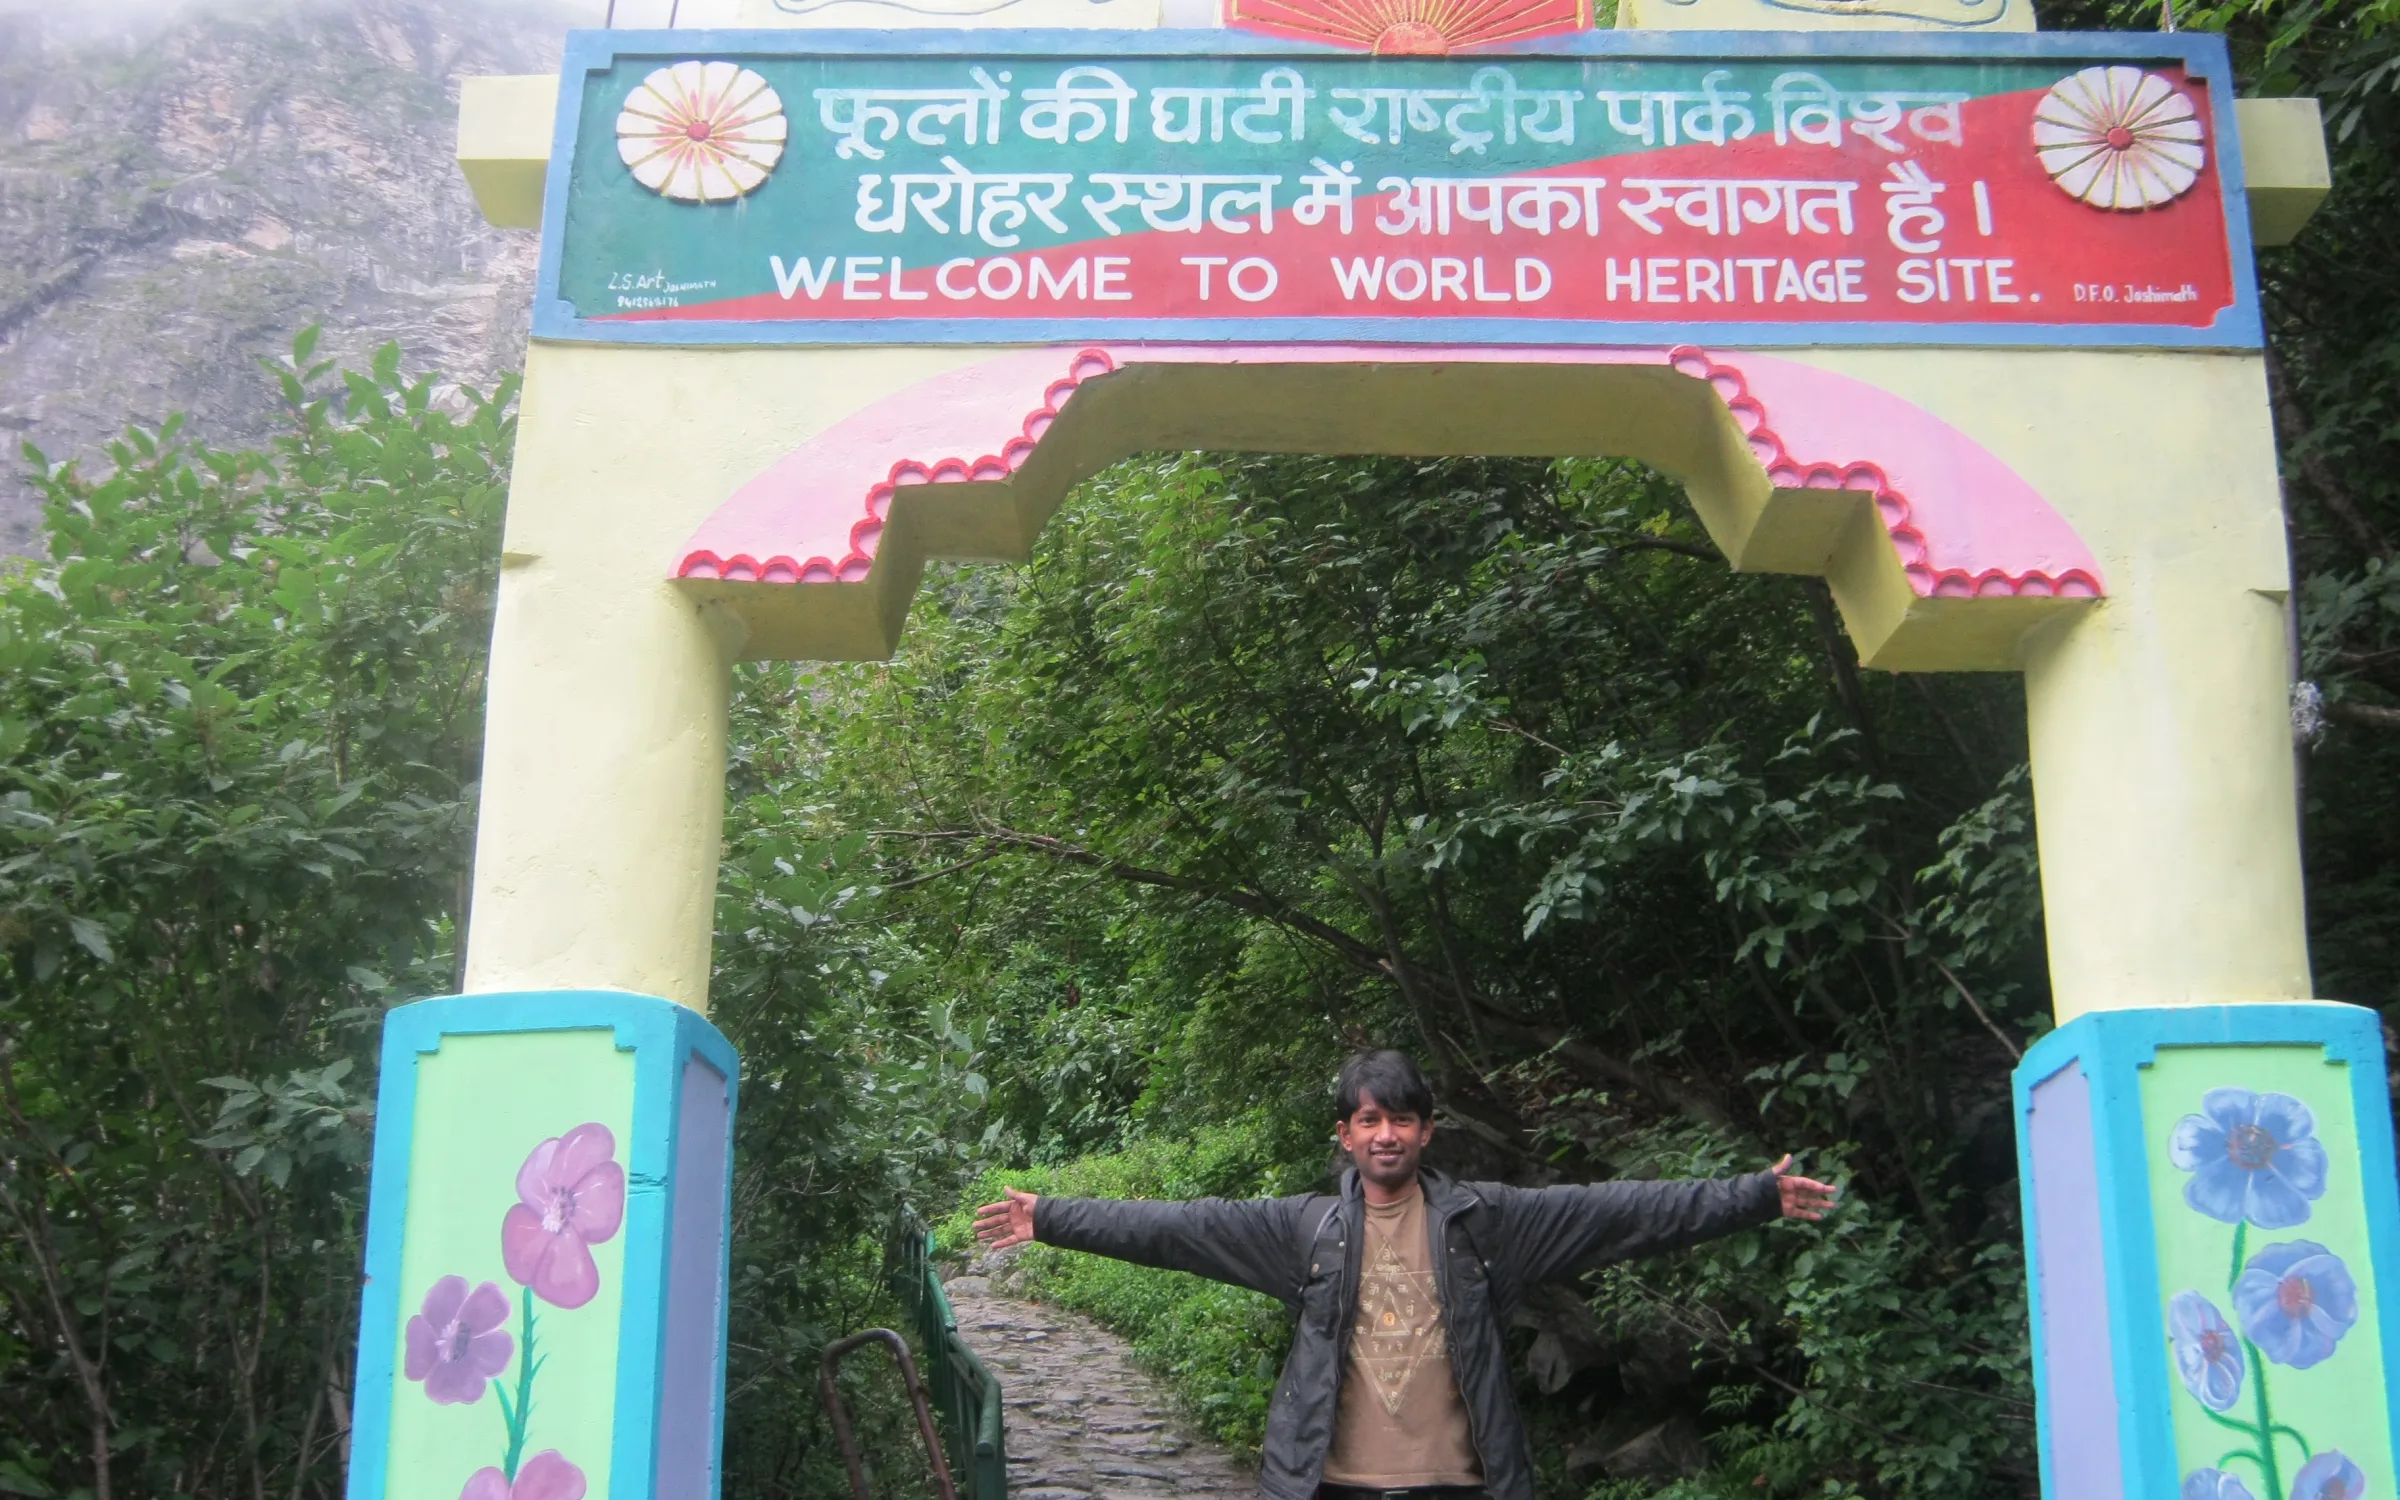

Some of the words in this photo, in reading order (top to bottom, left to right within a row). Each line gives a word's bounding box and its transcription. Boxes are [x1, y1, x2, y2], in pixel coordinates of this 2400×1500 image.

[814, 67, 1012, 160] फूलों
[1020, 66, 1138, 144] की
[1150, 66, 1316, 144] घाटी
[1329, 66, 1585, 156] राष्ट्रीय
[1597, 70, 1756, 147] पार्क
[1762, 71, 1972, 154] विश्व
[854, 156, 1074, 248] धरोहर
[1081, 172, 1283, 236] स्थल
[1292, 156, 1362, 235] में
[1375, 176, 1607, 237] आपका
[1617, 177, 1859, 236] स्वागत
[769, 255, 1133, 301] WELCOME
[1180, 256, 1279, 302] TO
[1330, 255, 1553, 302] WORLD
[1605, 257, 1869, 303] HERITAGE
[1896, 258, 2041, 304] SITE.
